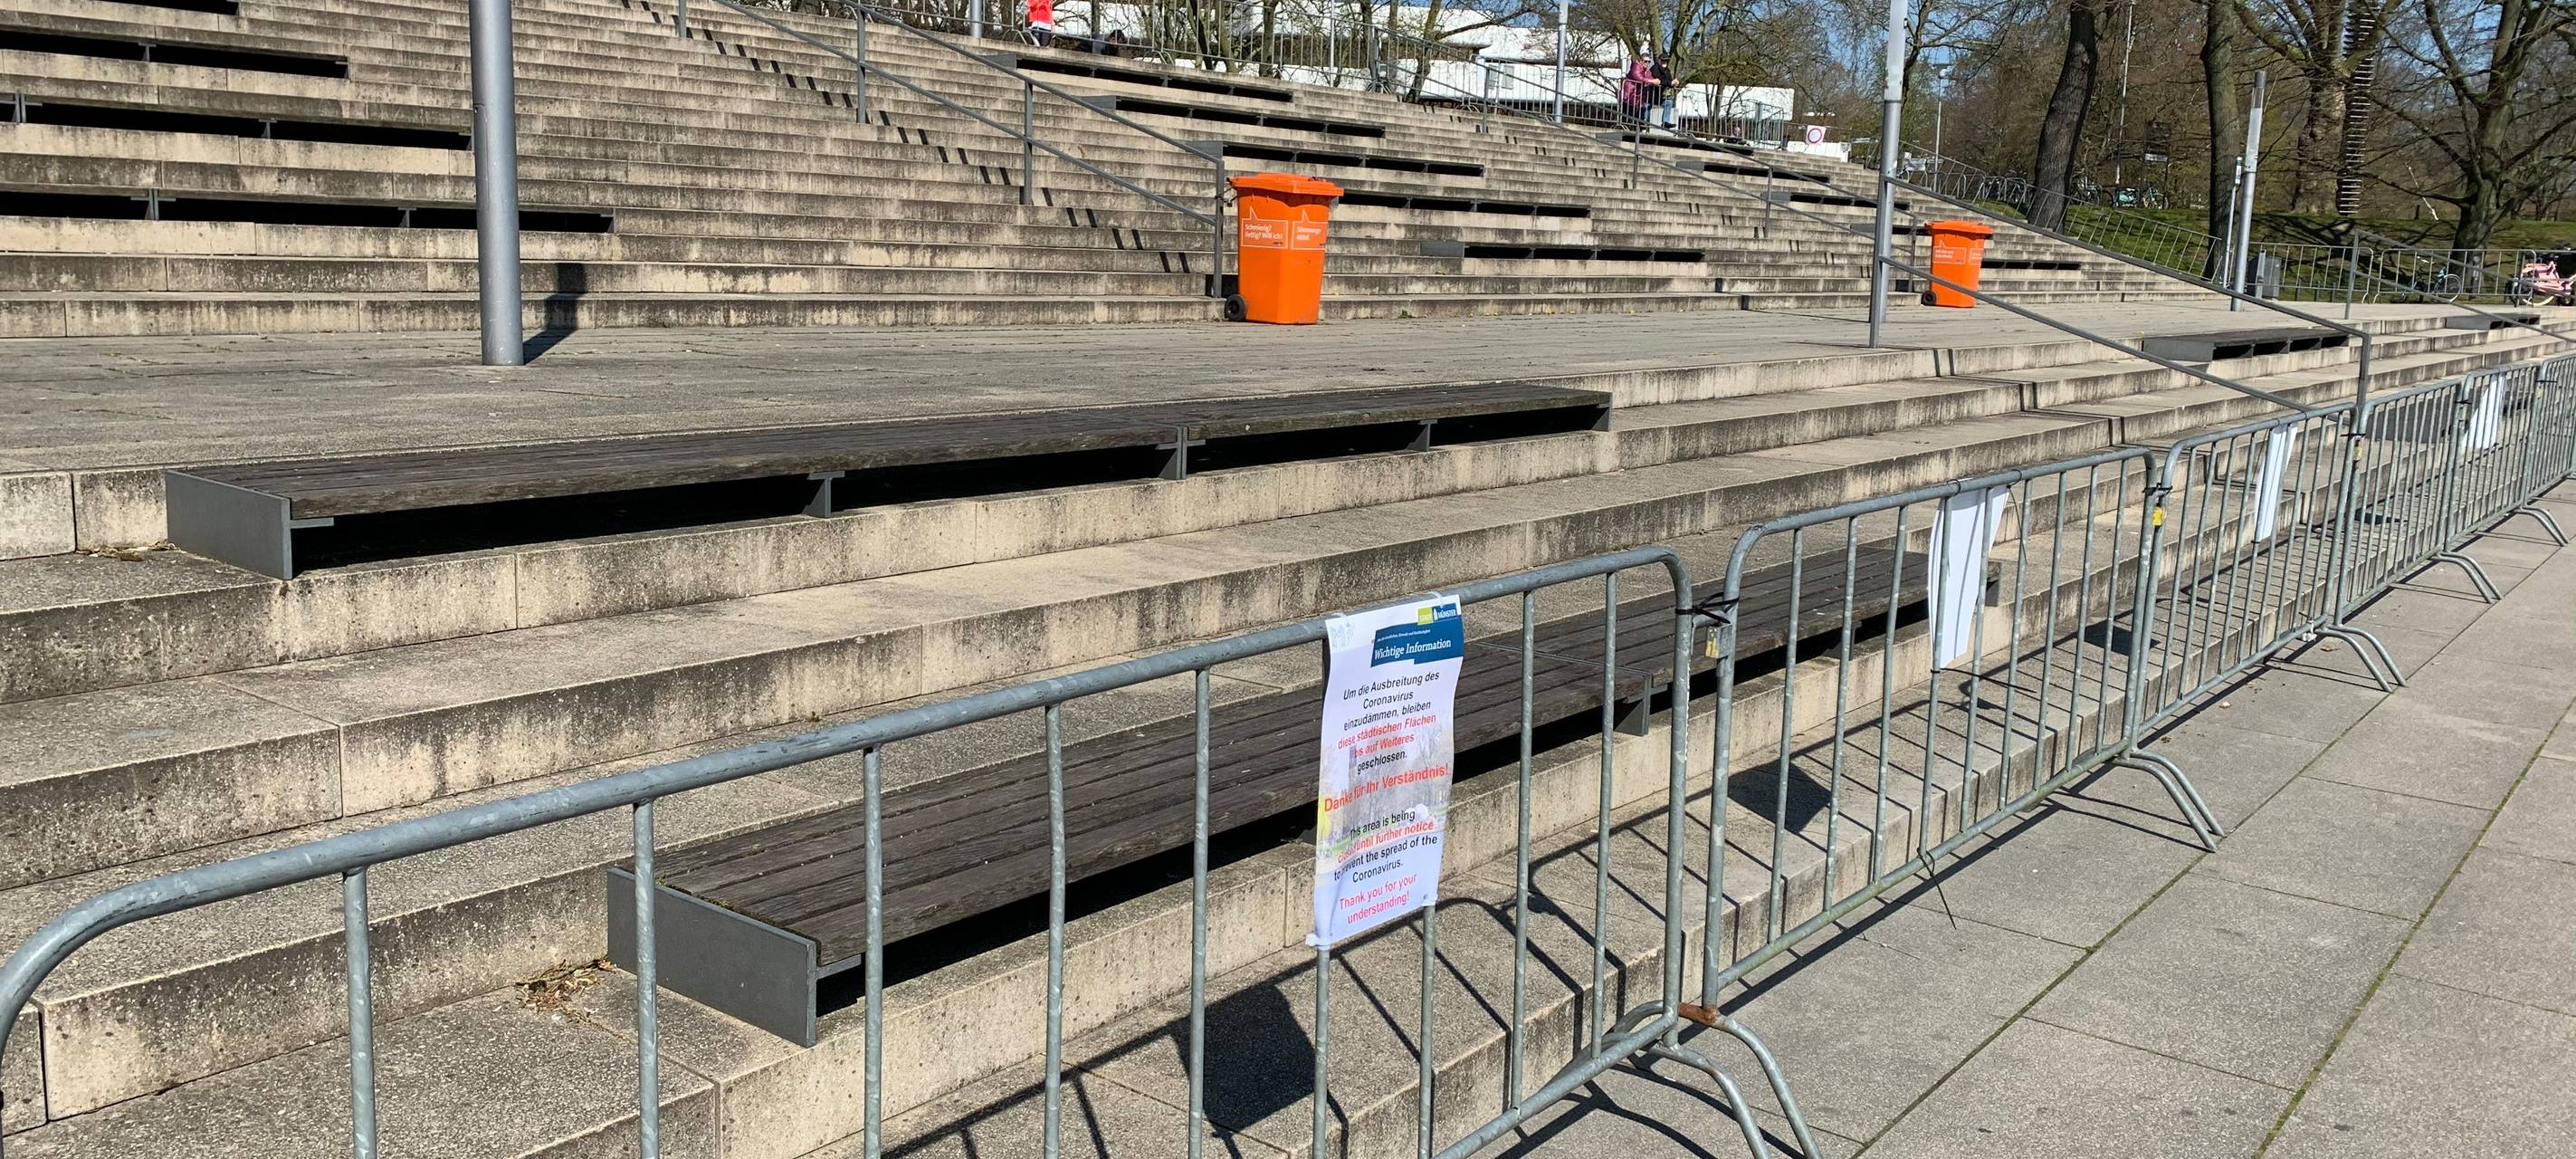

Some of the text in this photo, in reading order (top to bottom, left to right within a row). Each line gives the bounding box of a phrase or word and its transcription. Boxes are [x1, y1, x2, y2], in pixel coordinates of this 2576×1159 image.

[1438, 608, 1457, 619] MÜNSTER
[1375, 638, 1451, 660] Wichtige Information
[1343, 671, 1440, 700] Um die Ausbreitung des
[1363, 691, 1414, 709] Coronavirus
[1344, 701, 1431, 731] einzudämmen, bleiben
[1338, 714, 1436, 750] diese städtischen Flächen
[1365, 742, 1379, 754] auf
[1380, 734, 1415, 750] Weiteres
[1357, 751, 1407, 775] geschlossen.
[1325, 763, 1449, 812] Danke für Ihr Verständnis!
[1357, 837, 1374, 850] until
[1376, 830, 1402, 844] further
[1404, 821, 1434, 834] notice
[1363, 820, 1380, 833] area
[1382, 816, 1389, 826] is
[1391, 810, 1416, 824] being
[1334, 870, 1341, 881] to
[1366, 850, 1379, 863] the
[1381, 840, 1407, 858] spread
[1410, 836, 1419, 848] of
[1422, 835, 1438, 845] the
[1352, 858, 1403, 883] Coronavirus.
[1340, 874, 1417, 910] Thank you for your
[1347, 891, 1410, 924] understanding!
